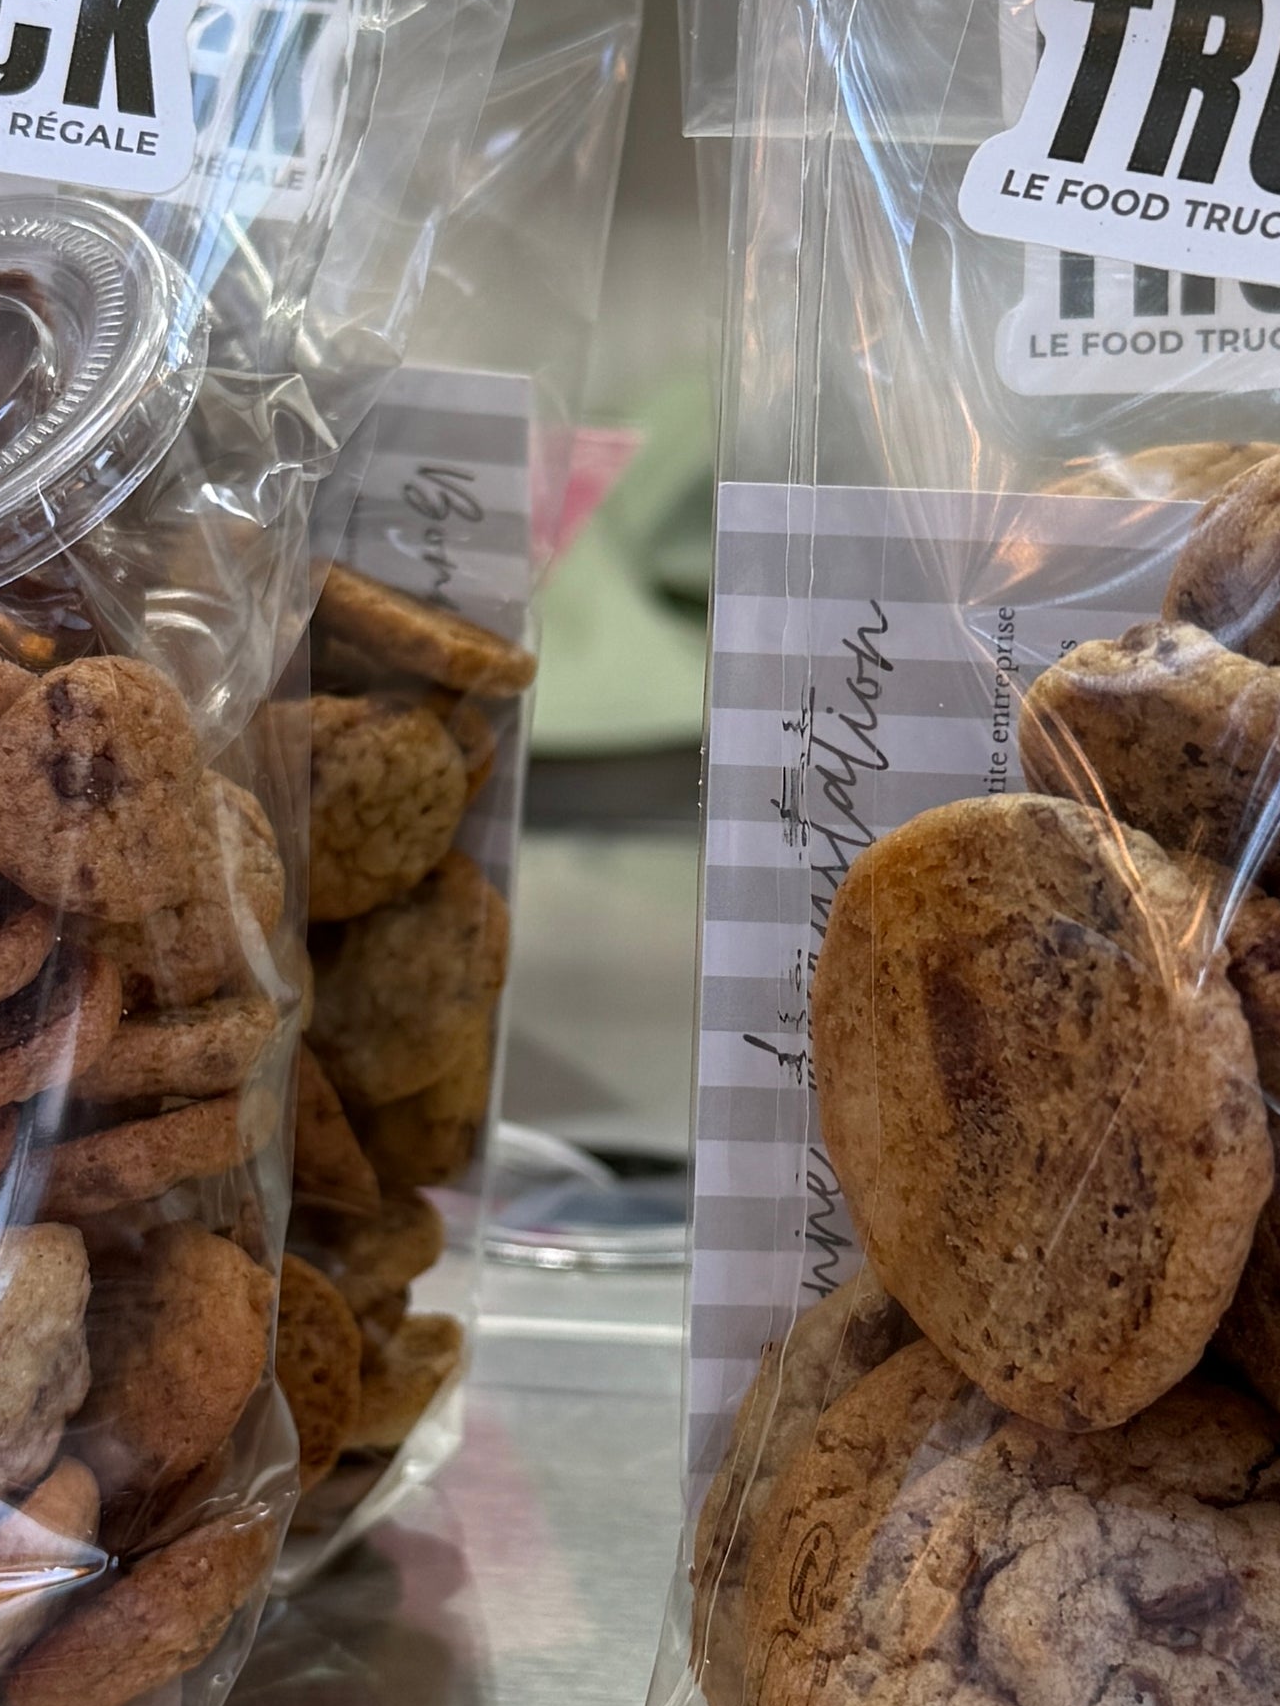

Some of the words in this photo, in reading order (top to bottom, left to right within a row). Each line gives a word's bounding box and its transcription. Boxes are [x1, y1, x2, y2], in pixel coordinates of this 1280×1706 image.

[9, 110, 160, 157] RÉGALE
[1001, 169, 1044, 201] LE
[1057, 179, 1170, 222] FOOD
[1030, 334, 1068, 359] LE
[1082, 330, 1183, 357] FOOD
[988, 606, 1018, 745] entreprise
